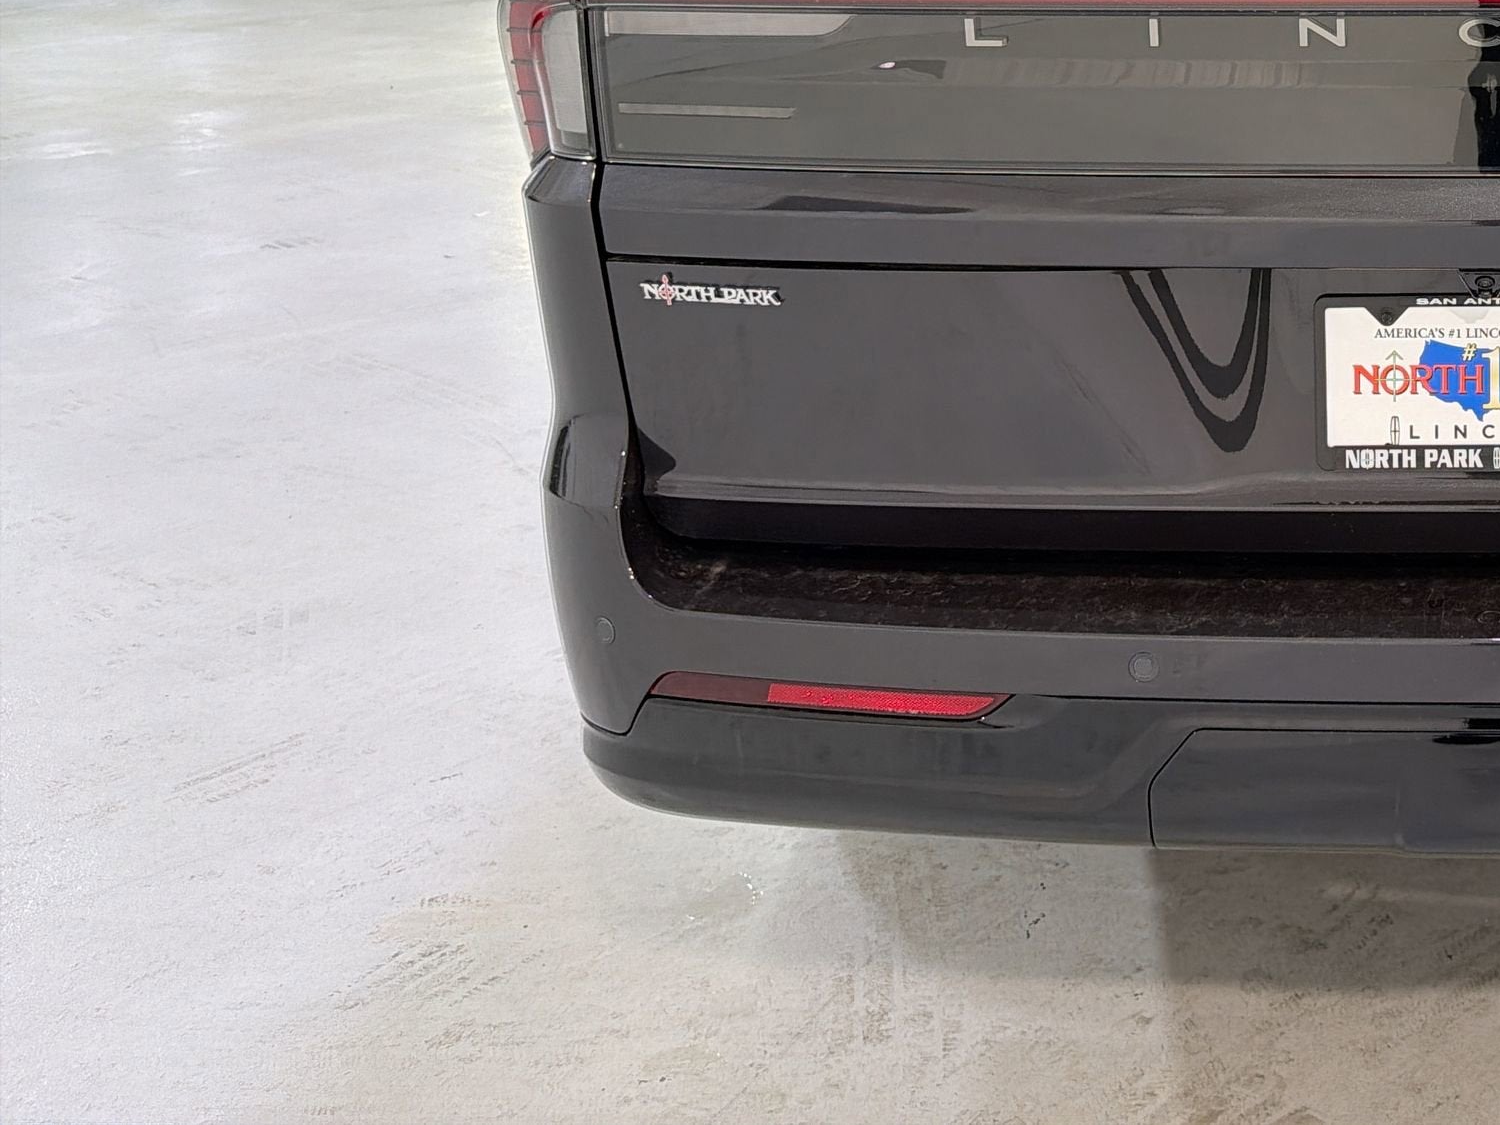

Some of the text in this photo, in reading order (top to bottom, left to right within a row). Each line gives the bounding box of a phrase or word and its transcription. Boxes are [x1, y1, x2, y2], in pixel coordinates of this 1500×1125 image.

[639, 282, 782, 306] NORTH PARK
[1415, 297, 1457, 306] SAN
[1374, 327, 1445, 339] AMERICA'S
[1448, 327, 1461, 339] #1
[1352, 363, 1485, 395] NORTH
[1345, 448, 1417, 470] NORTH
[1424, 448, 1484, 469] PARK
